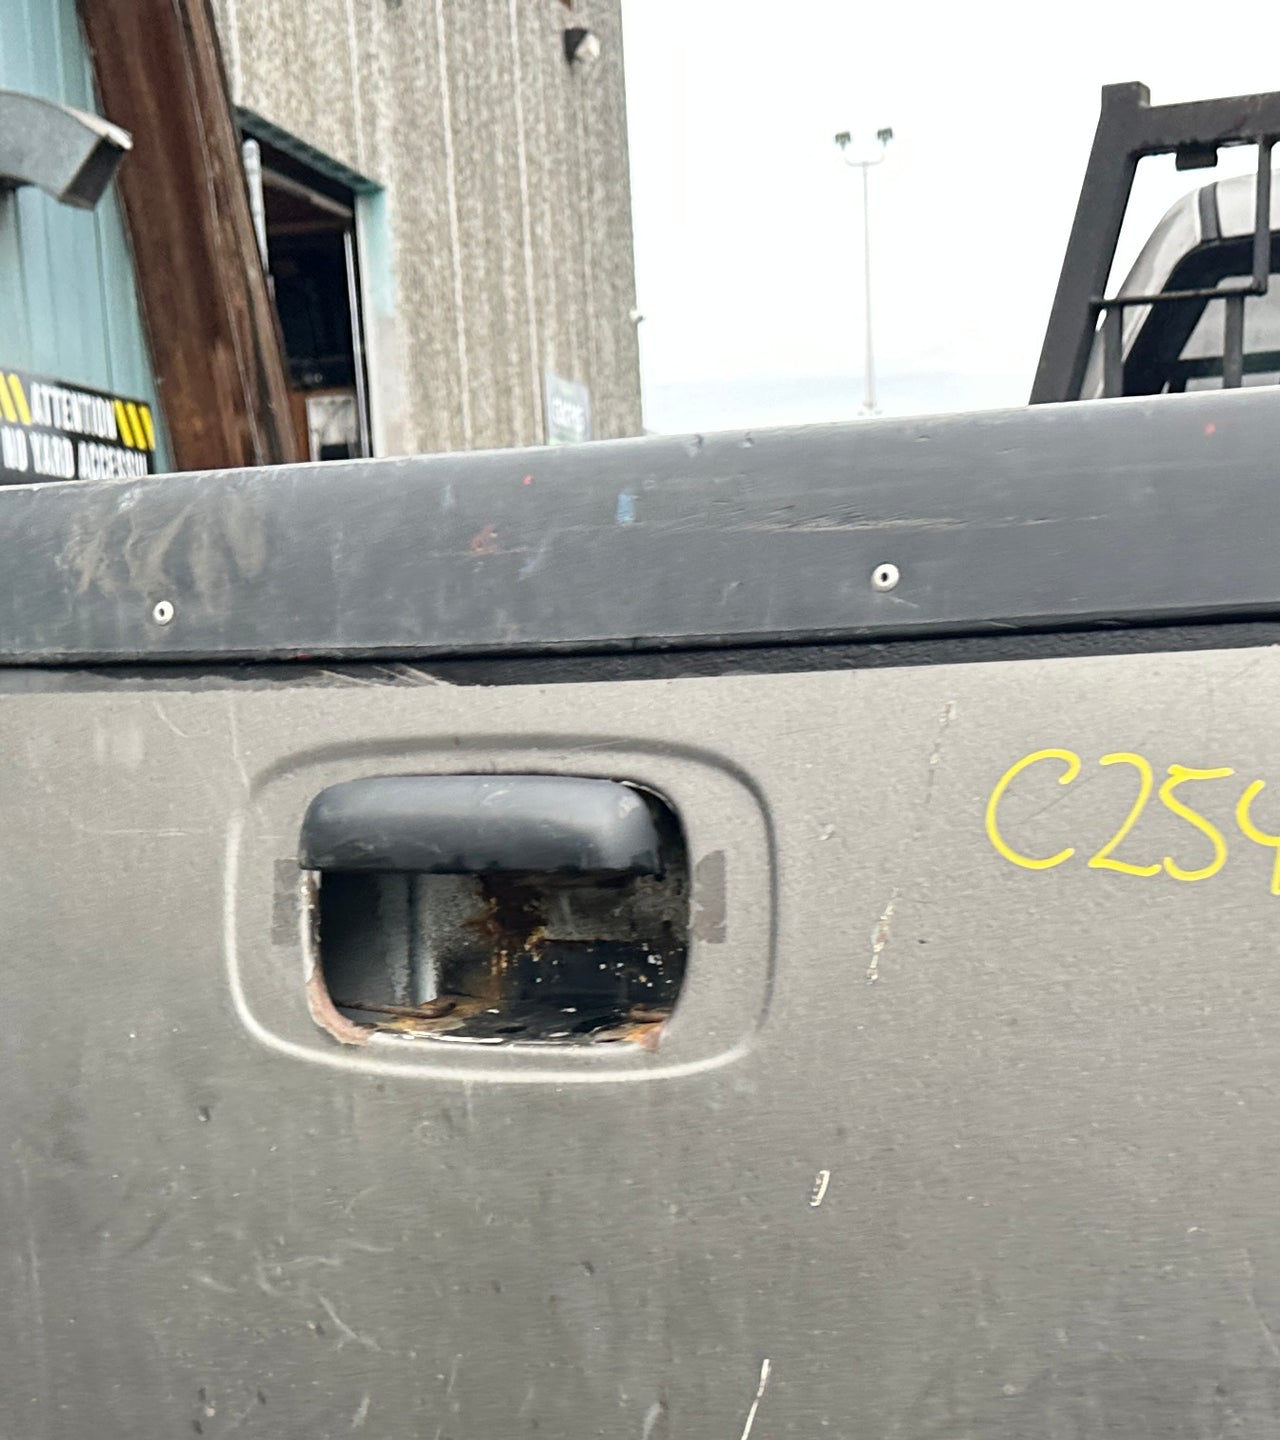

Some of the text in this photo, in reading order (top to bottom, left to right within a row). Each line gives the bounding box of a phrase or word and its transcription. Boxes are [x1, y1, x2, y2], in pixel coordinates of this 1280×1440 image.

[30, 382, 117, 440] ATTENTION
[1, 425, 28, 472] NO
[29, 431, 75, 479] YARD
